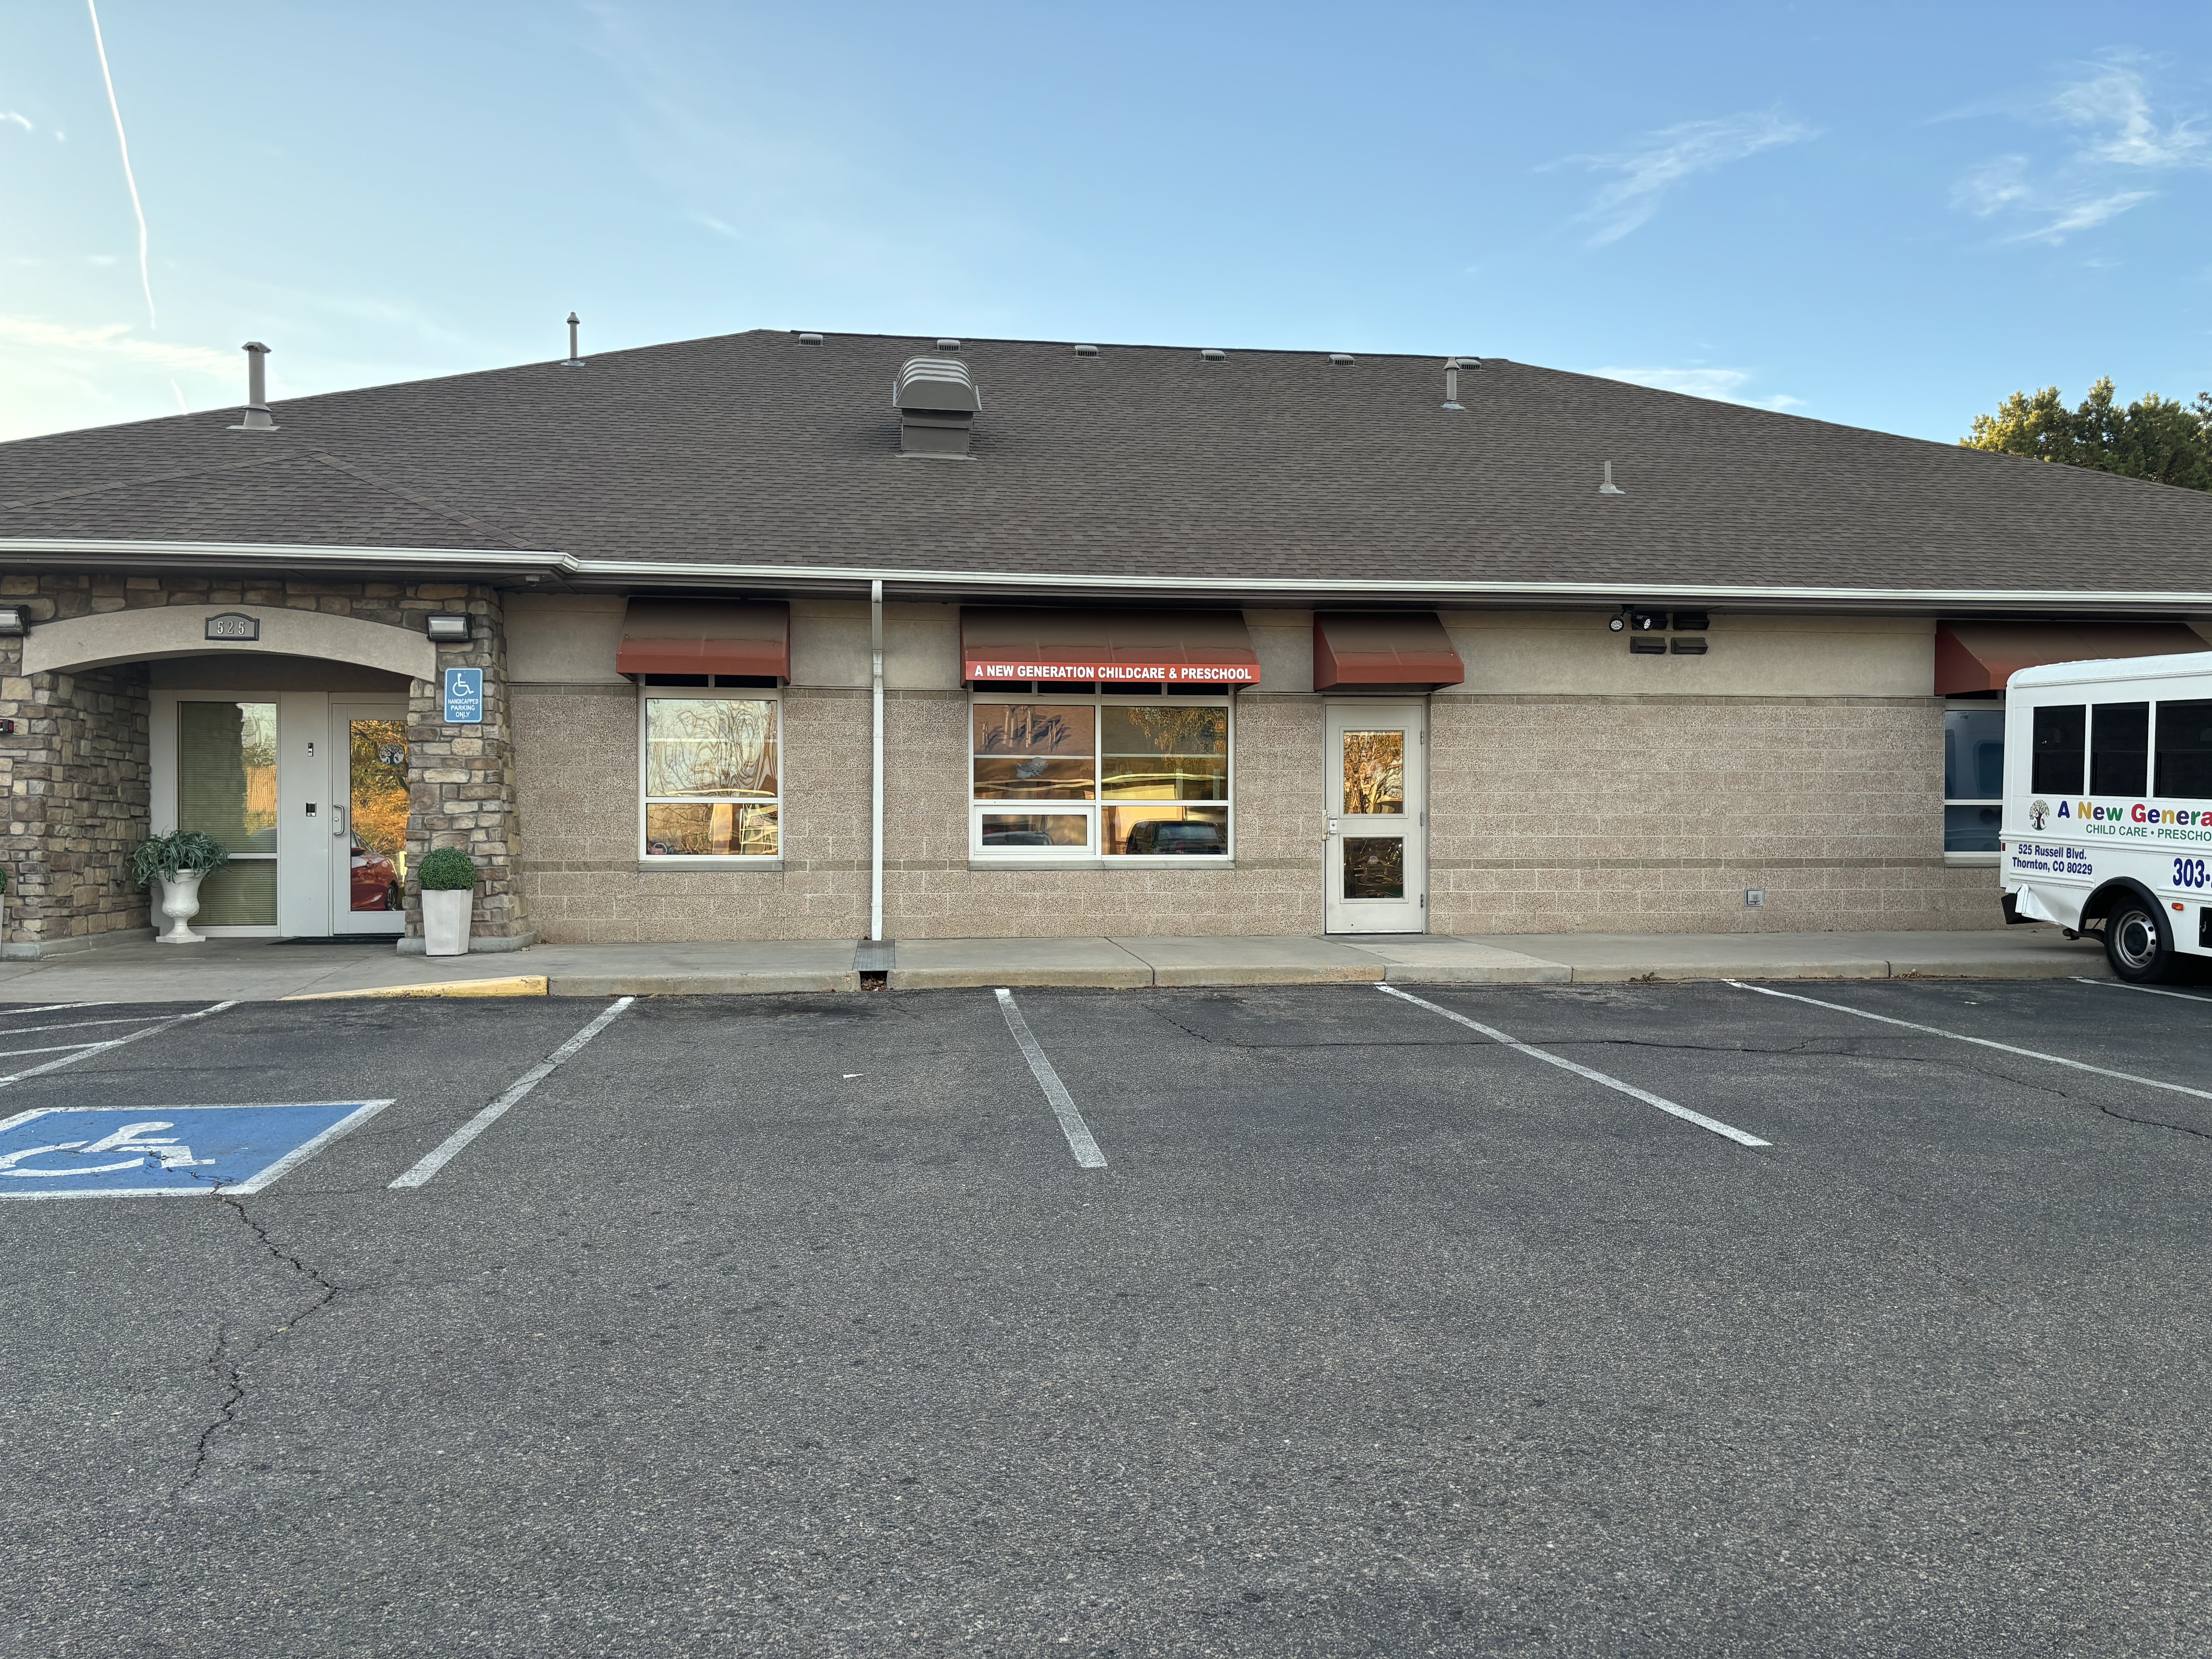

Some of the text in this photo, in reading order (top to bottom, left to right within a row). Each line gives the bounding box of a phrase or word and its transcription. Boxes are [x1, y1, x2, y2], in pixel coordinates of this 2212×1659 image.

[218, 621, 244, 634] 525
[975, 665, 1252, 679] A NEW GENERATION CHILDCARE & PRESCHOOL
[2057, 800, 2212, 826] A New Genera
[2086, 824, 2212, 842] CHILD CARE PRESCHO
[2018, 844, 2087, 860] 525 Russell Blvd.
[2012, 857, 2092, 875] Thornton, CO 80229
[2173, 858, 2212, 888] 303-
